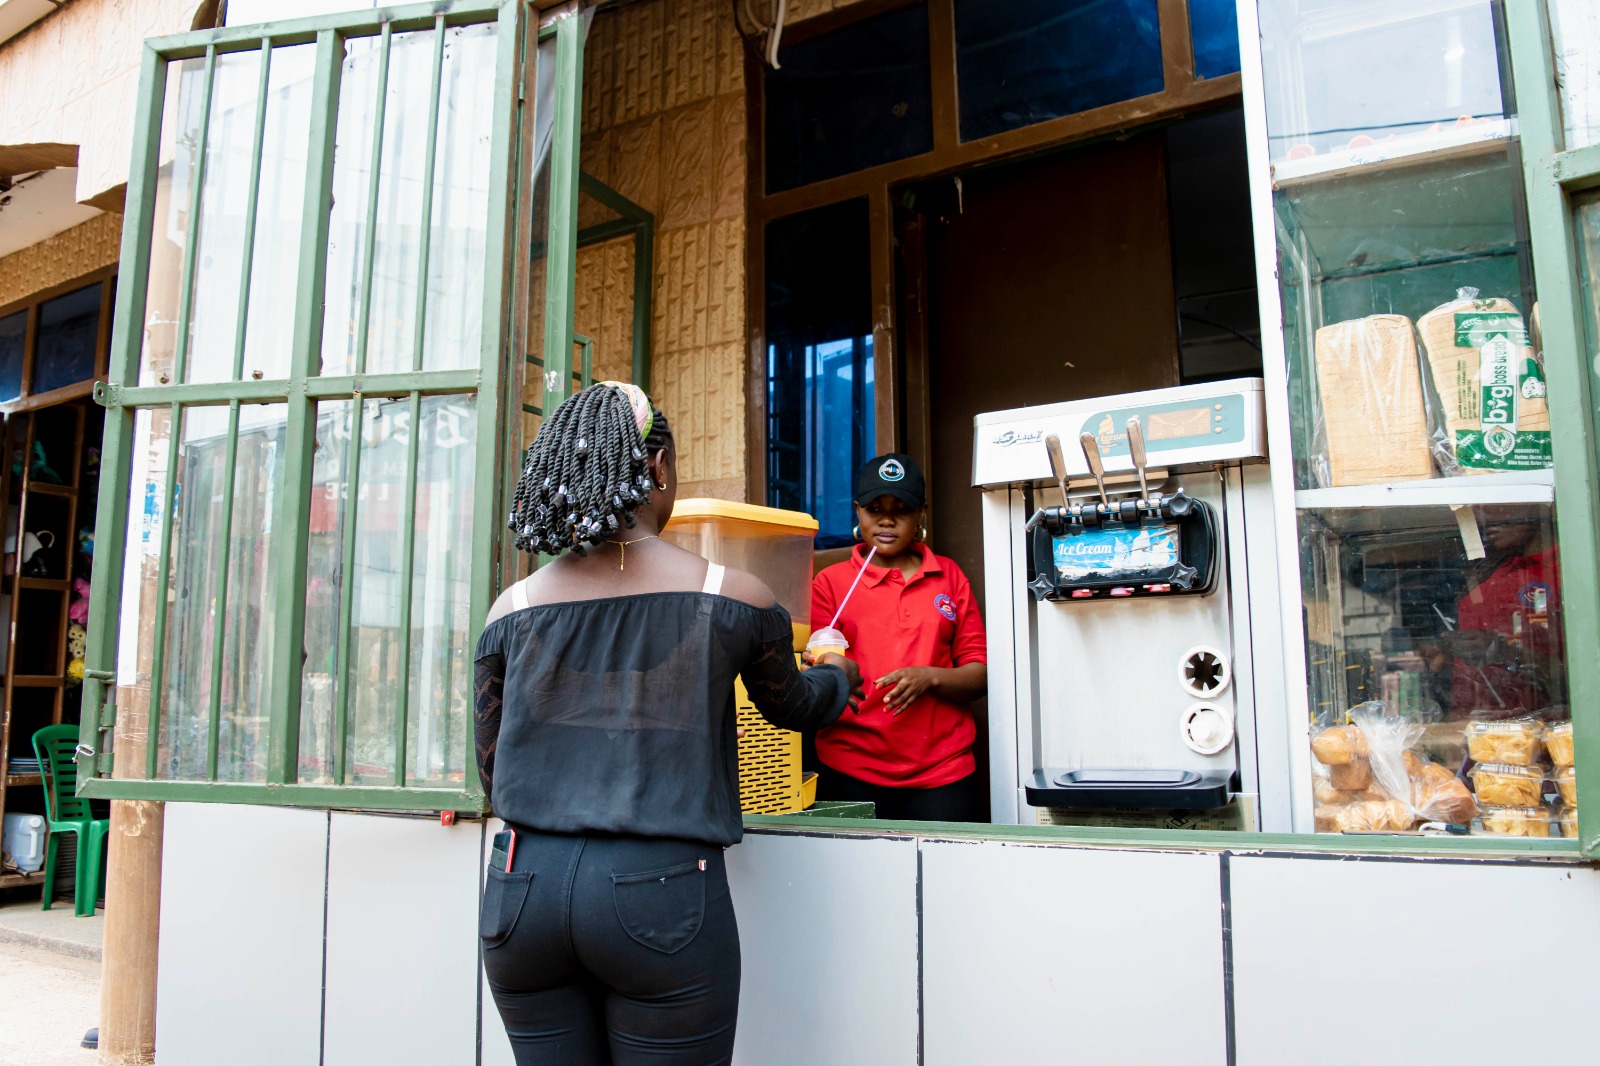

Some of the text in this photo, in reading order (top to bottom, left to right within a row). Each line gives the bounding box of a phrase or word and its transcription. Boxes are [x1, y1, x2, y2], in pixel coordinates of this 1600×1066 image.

[1490, 341, 1507, 364] bread
[1490, 365, 1507, 385] boss
[1058, 542, 1112, 555] Ice Cream
